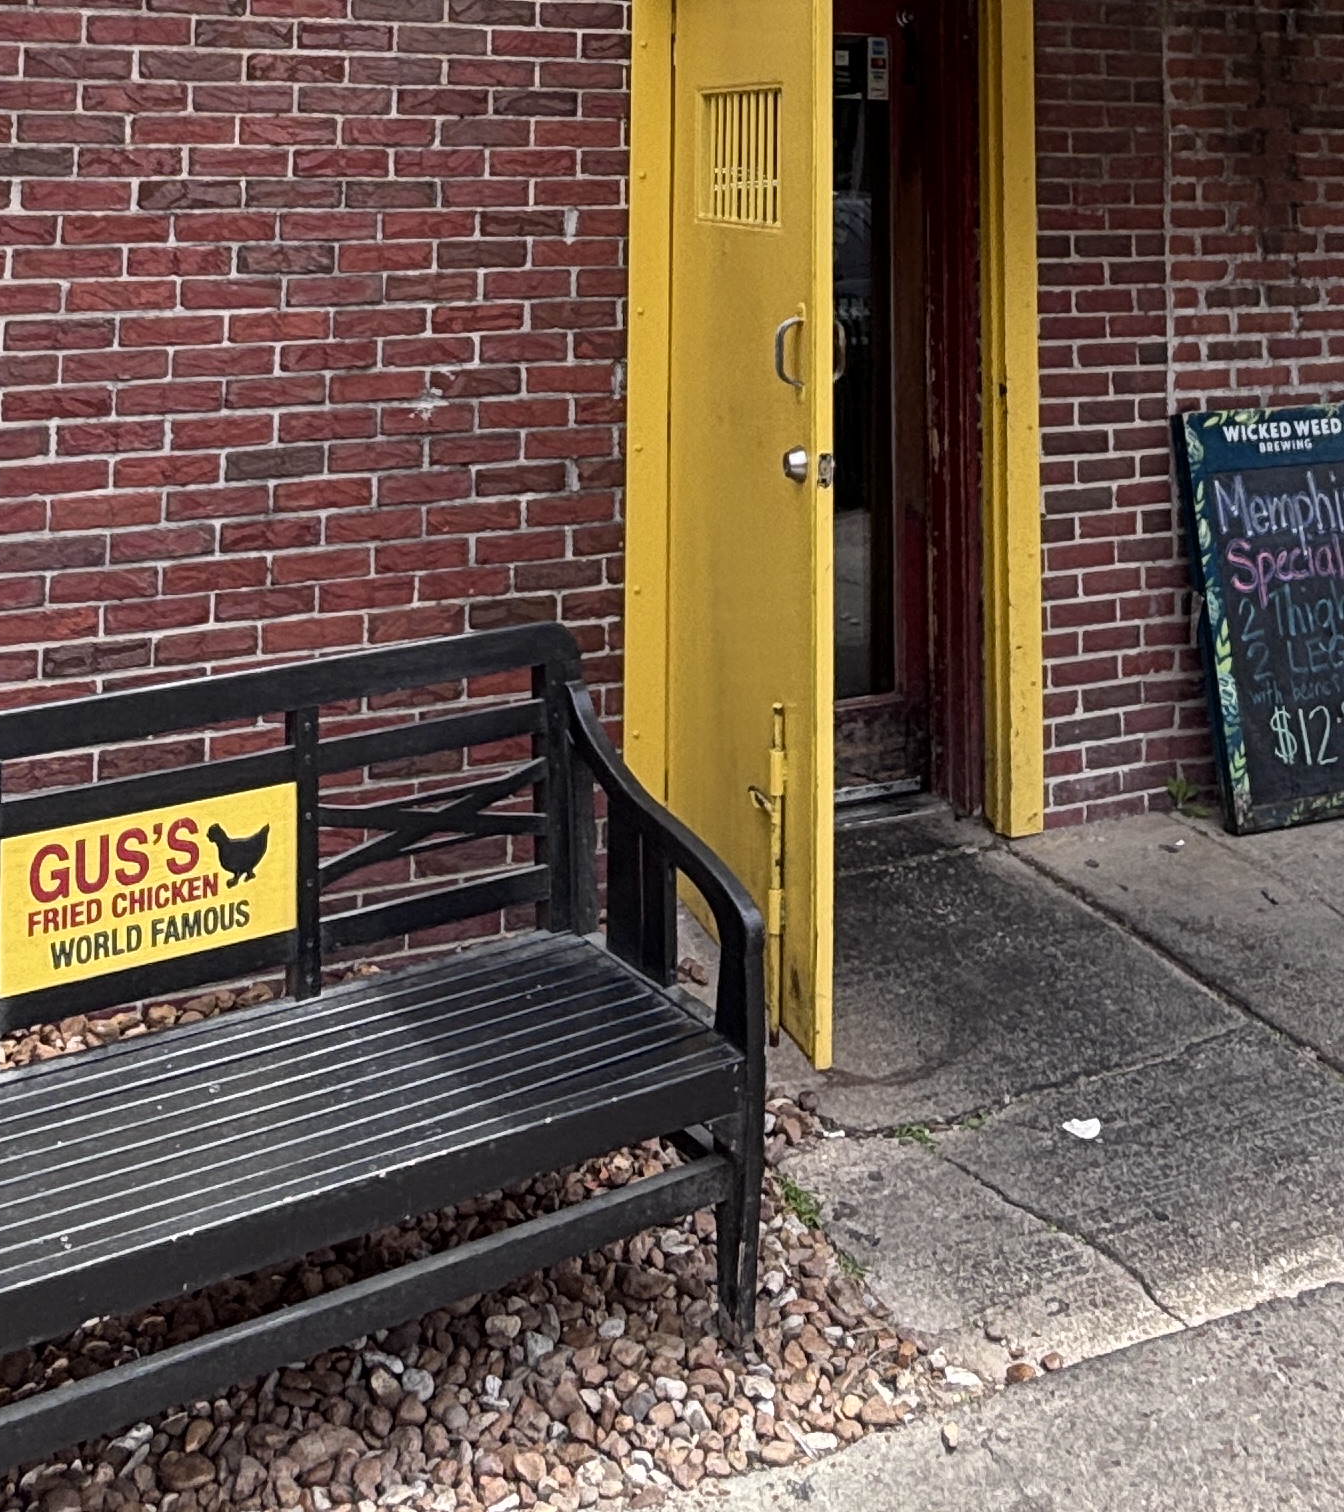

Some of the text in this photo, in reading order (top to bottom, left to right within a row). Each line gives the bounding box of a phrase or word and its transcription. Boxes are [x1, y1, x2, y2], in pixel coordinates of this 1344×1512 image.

[1222, 418, 1342, 442] WICKED WEED
[1258, 438, 1313, 453] BREWING
[1238, 597, 1265, 641] 2
[1246, 641, 1273, 681] 2
[30, 817, 200, 903] GUS'S
[28, 873, 219, 937] FRIED CHICKEN
[51, 899, 250, 970] WORLD FAMOUS
